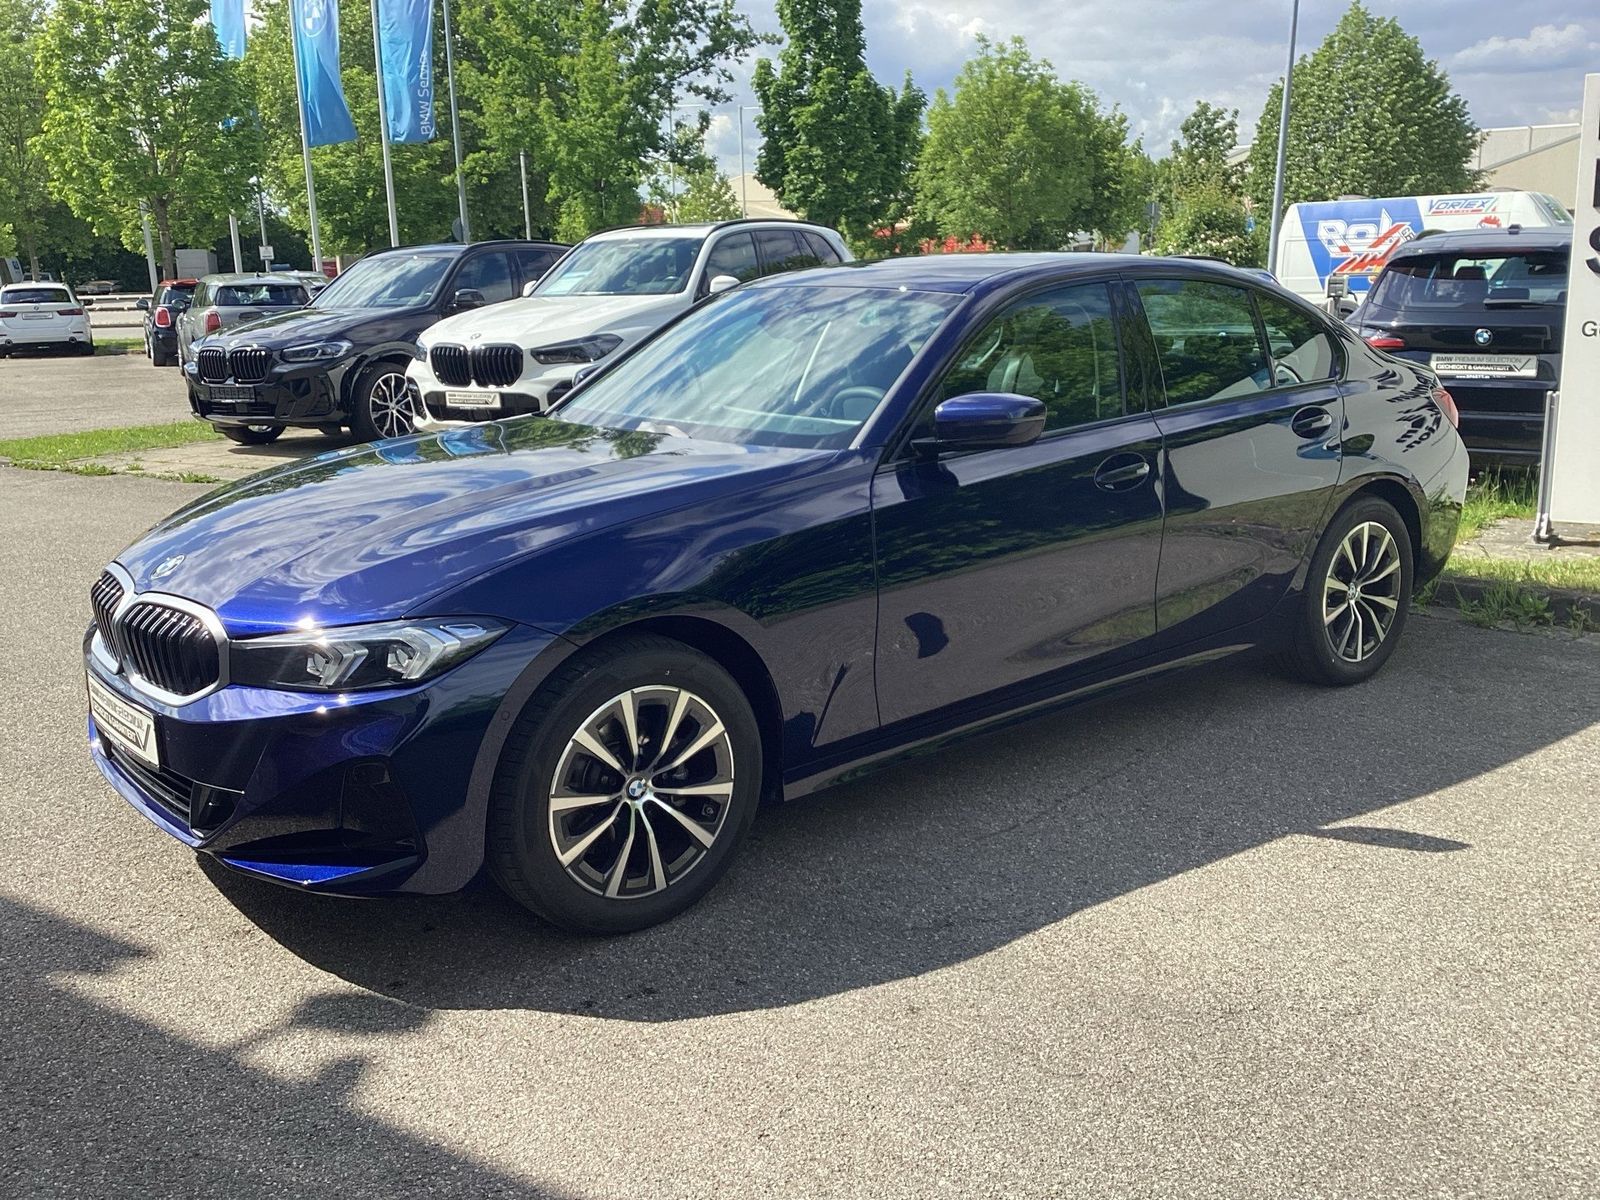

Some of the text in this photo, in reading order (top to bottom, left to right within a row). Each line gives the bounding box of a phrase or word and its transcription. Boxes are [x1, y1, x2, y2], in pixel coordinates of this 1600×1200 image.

[418, 100, 432, 135] BMW
[1428, 197, 1491, 212] VORTEX
[1486, 356, 1522, 364] SELECTION
